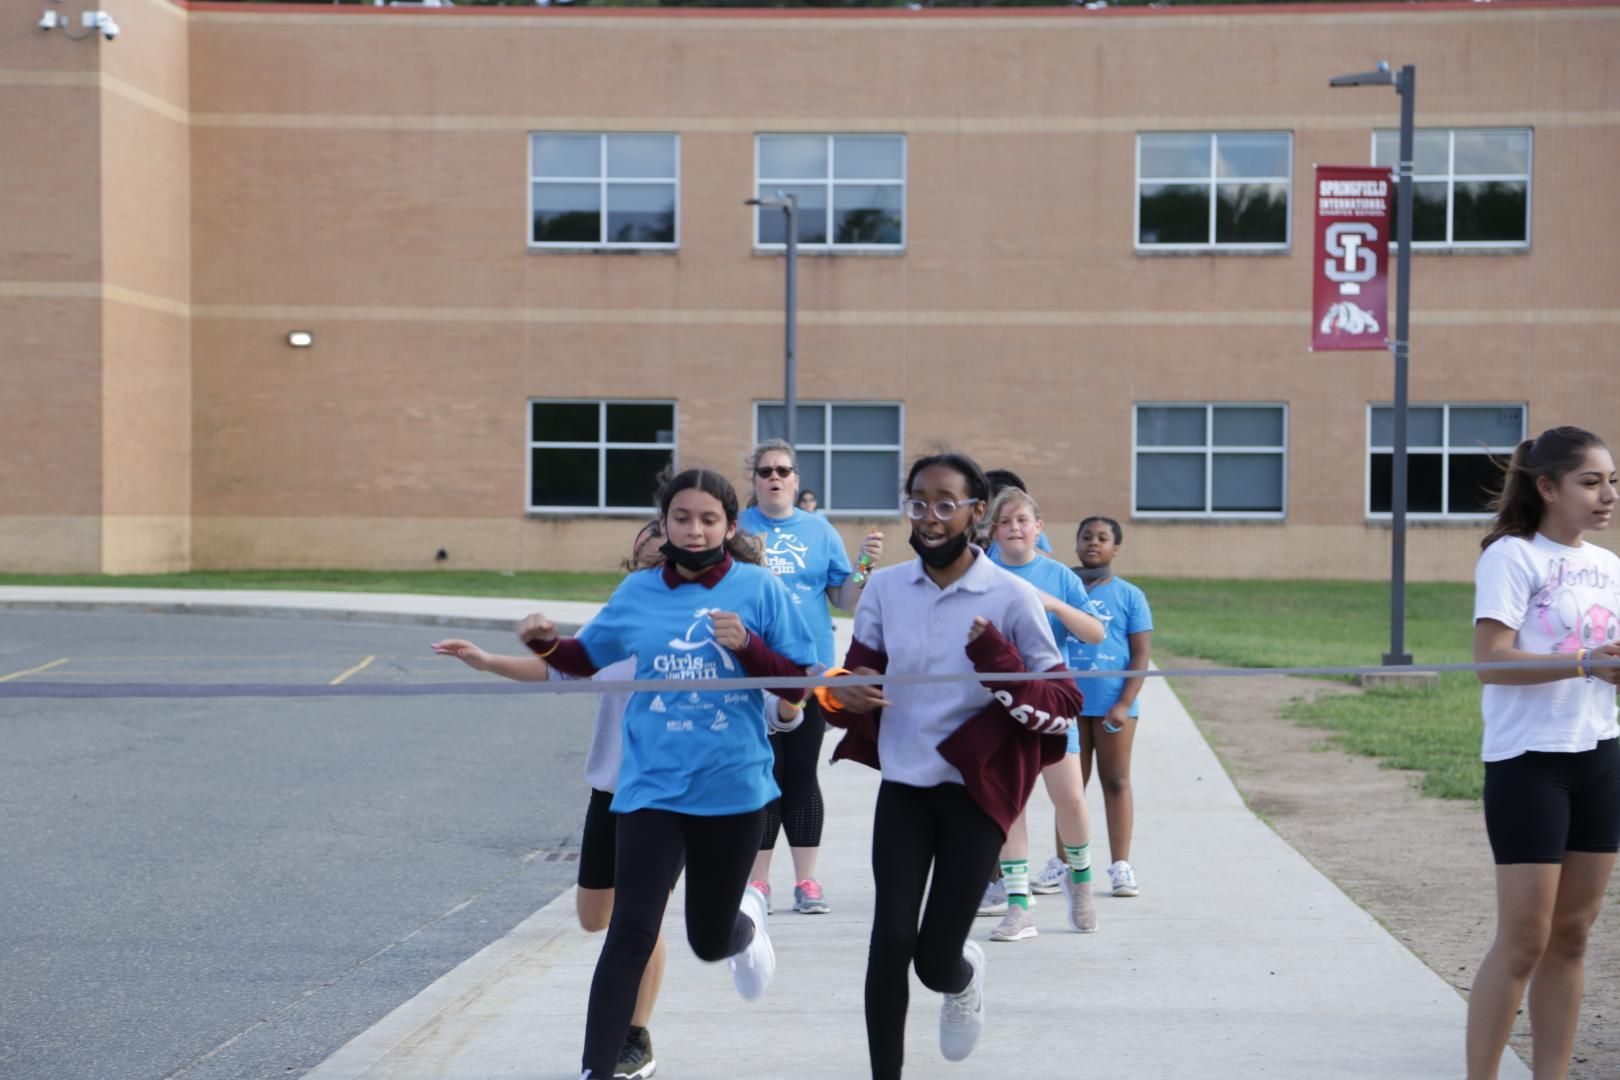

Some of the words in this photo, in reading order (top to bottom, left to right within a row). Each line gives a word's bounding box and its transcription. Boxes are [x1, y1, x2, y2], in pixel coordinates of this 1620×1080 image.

[1319, 179, 1387, 197] SPRINGFIELD
[1319, 197, 1387, 210] INTERNATIONAL
[653, 653, 704, 672] Girls
